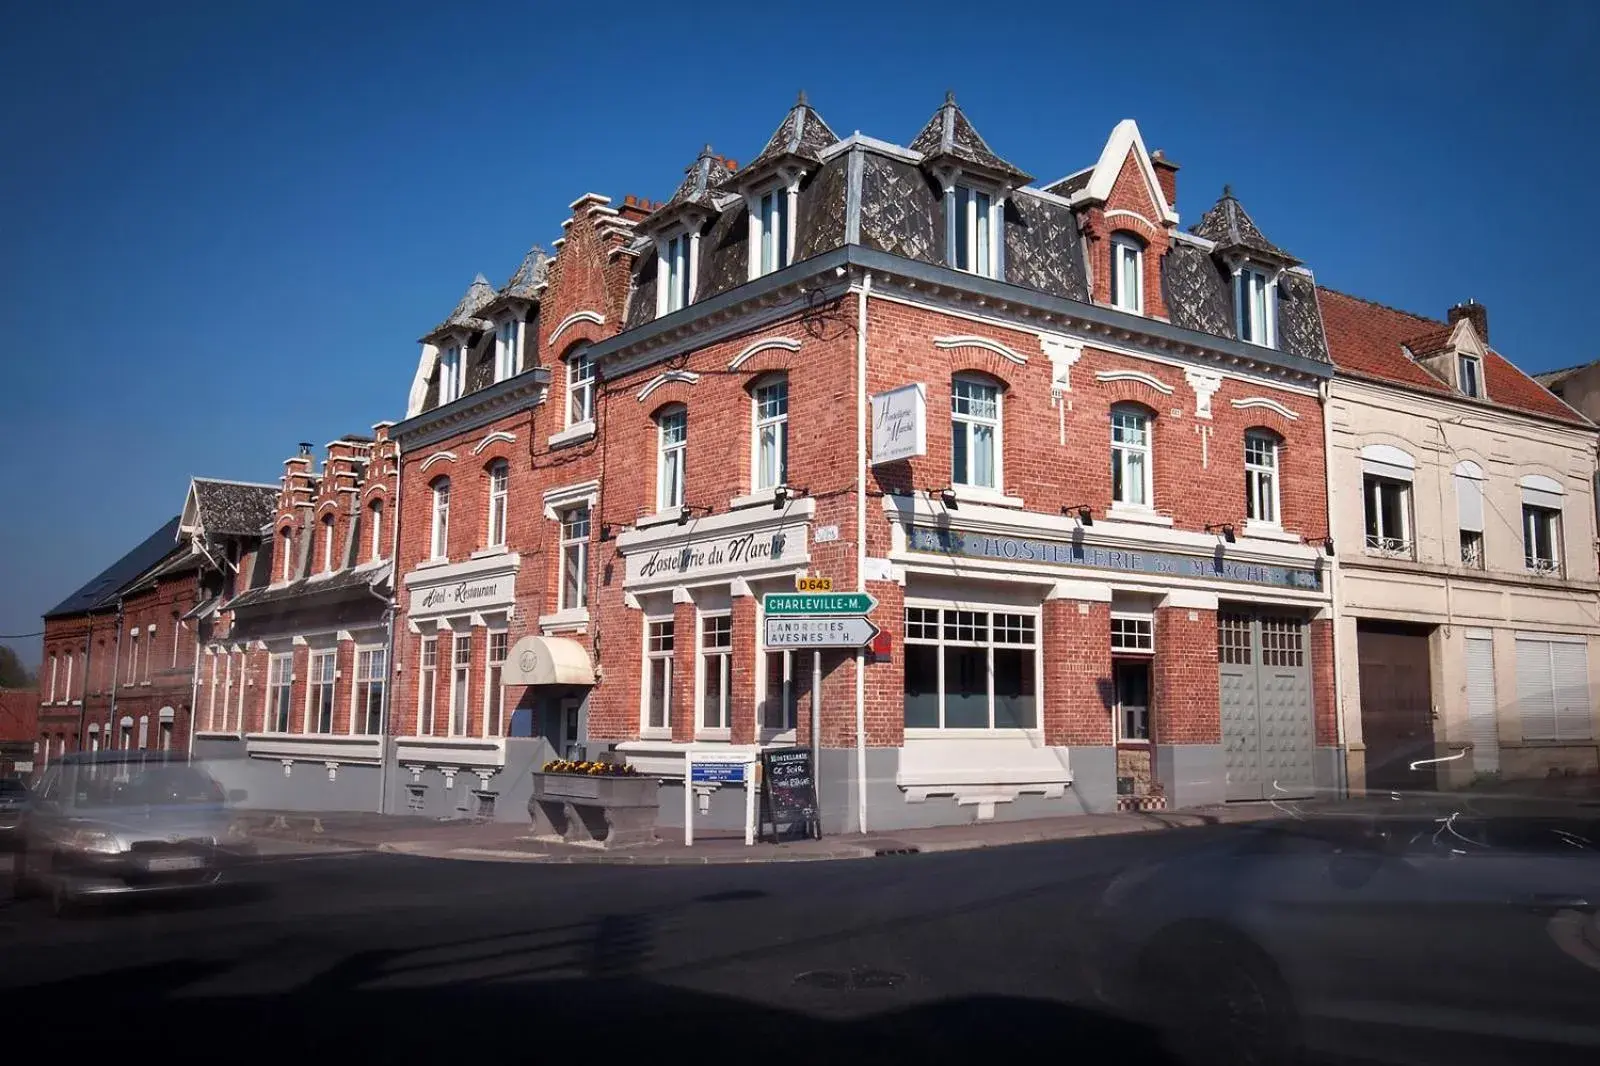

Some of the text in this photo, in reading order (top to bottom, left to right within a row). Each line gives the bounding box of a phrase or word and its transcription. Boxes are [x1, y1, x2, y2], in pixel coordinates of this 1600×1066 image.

[640, 551, 705, 577] Hostellerie
[708, 545, 723, 565] du
[800, 580, 831, 590] D 643
[454, 582, 497, 603] Restaurant
[769, 598, 861, 610] CHARLEVILLE-M.
[770, 622, 844, 632] LANDRECIES
[771, 633, 823, 642] AVESNES
